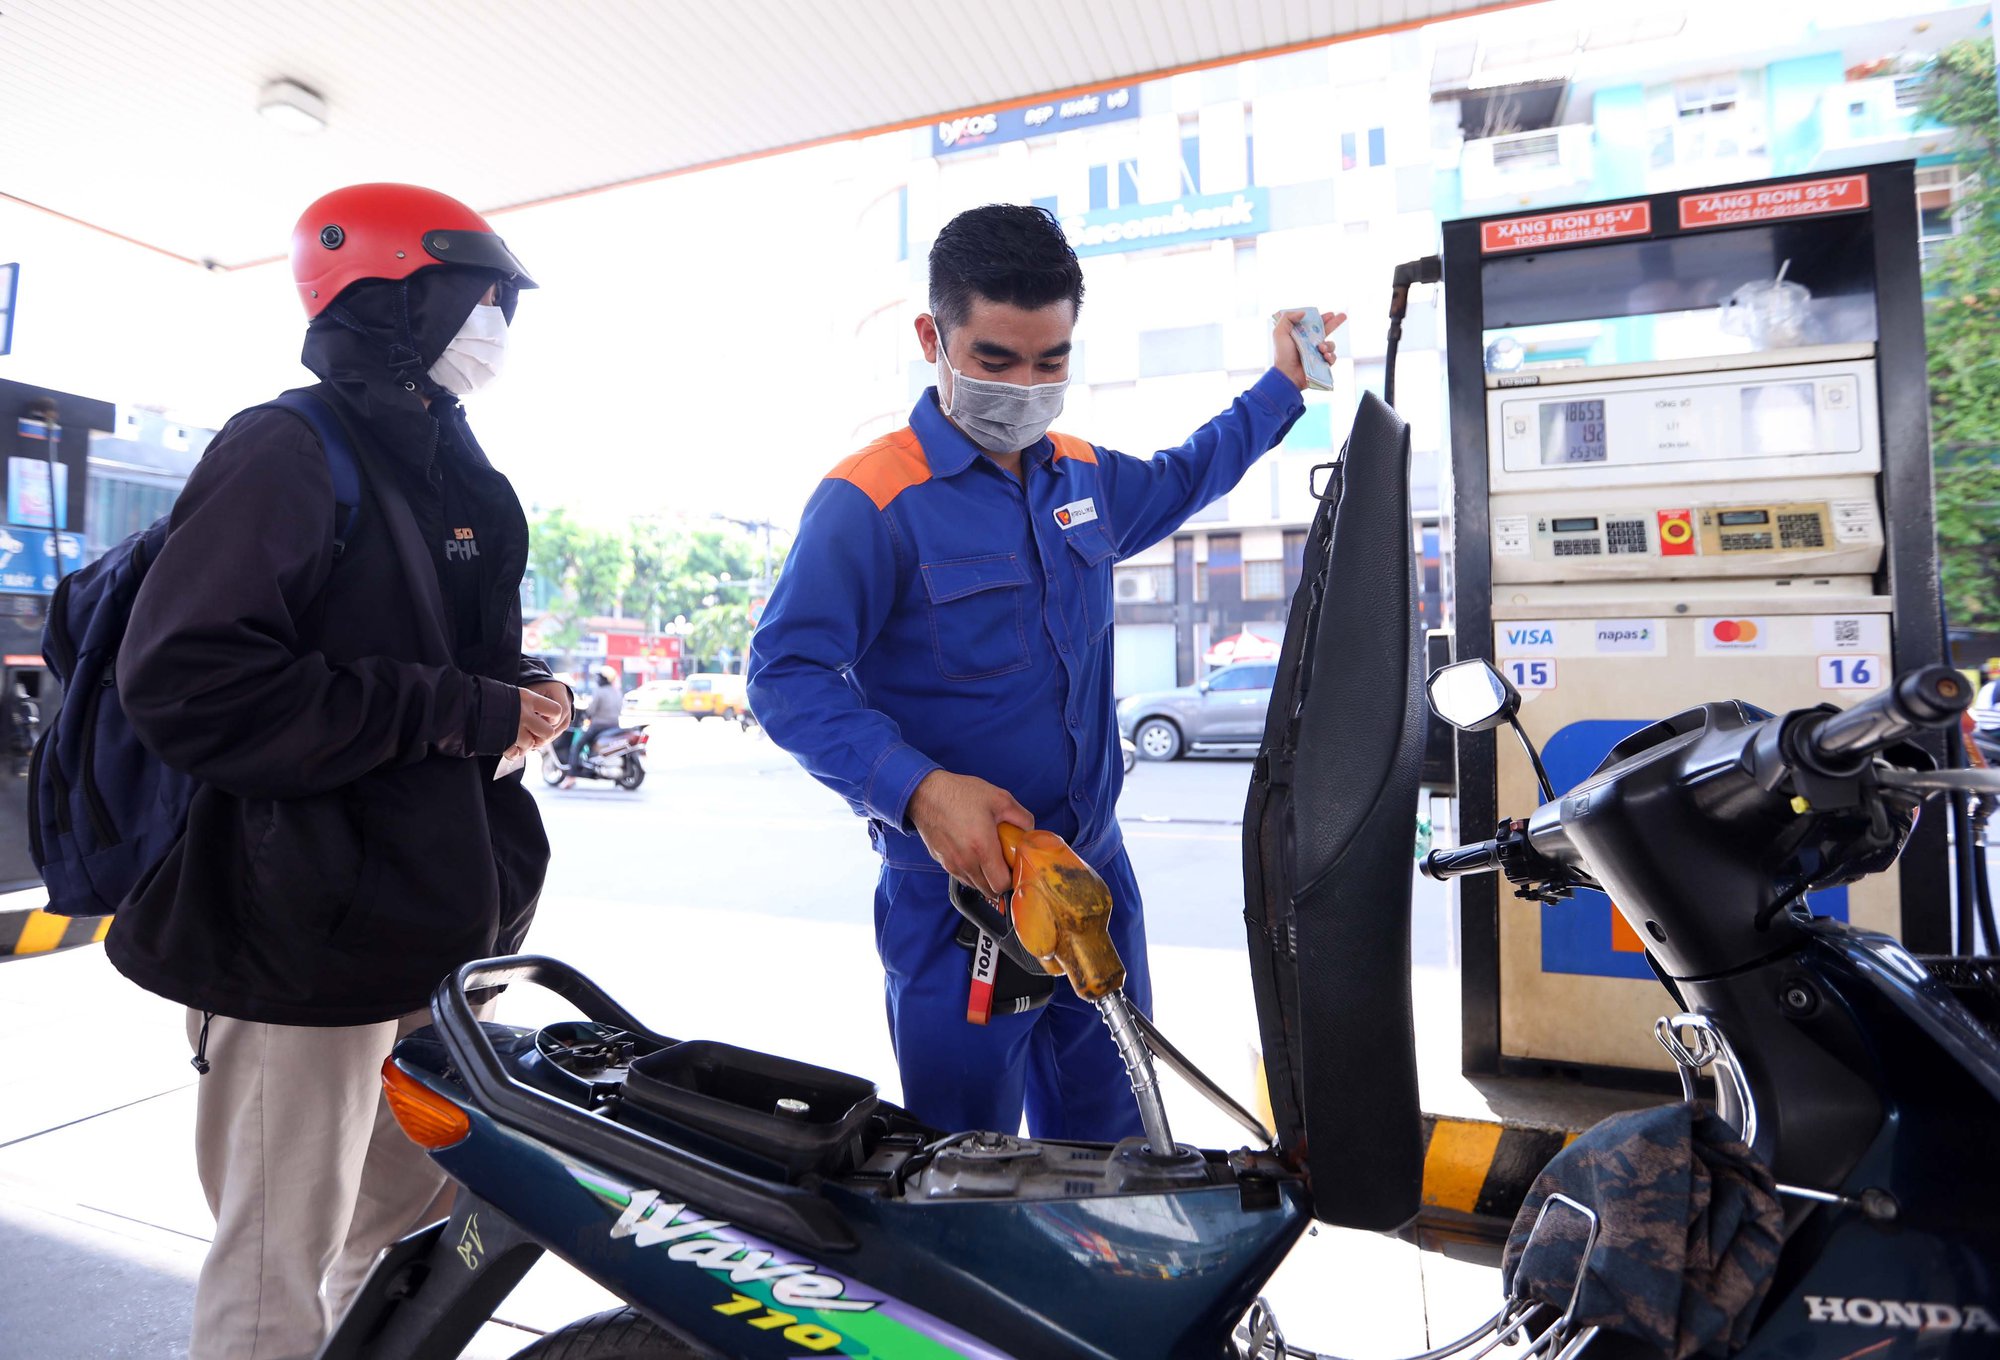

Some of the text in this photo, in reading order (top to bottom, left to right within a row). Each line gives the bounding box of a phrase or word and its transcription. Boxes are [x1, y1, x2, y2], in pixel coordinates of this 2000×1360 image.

[1757, 189, 1802, 205] RON
[1806, 182, 1849, 200] 95-V
[1061, 194, 1254, 248] Sacombank
[1551, 215, 1591, 231] RON
[1595, 208, 1634, 225] 95-V
[1514, 232, 1545, 246] TCCS
[1507, 629, 1554, 645] VISA
[1598, 630, 1638, 643] napas
[1512, 662, 1548, 686] 15
[1829, 659, 1871, 684] 16
[610, 1189, 877, 1312] Wave
[712, 1293, 842, 1351] 110
[1803, 1295, 2000, 1333] HONDA
